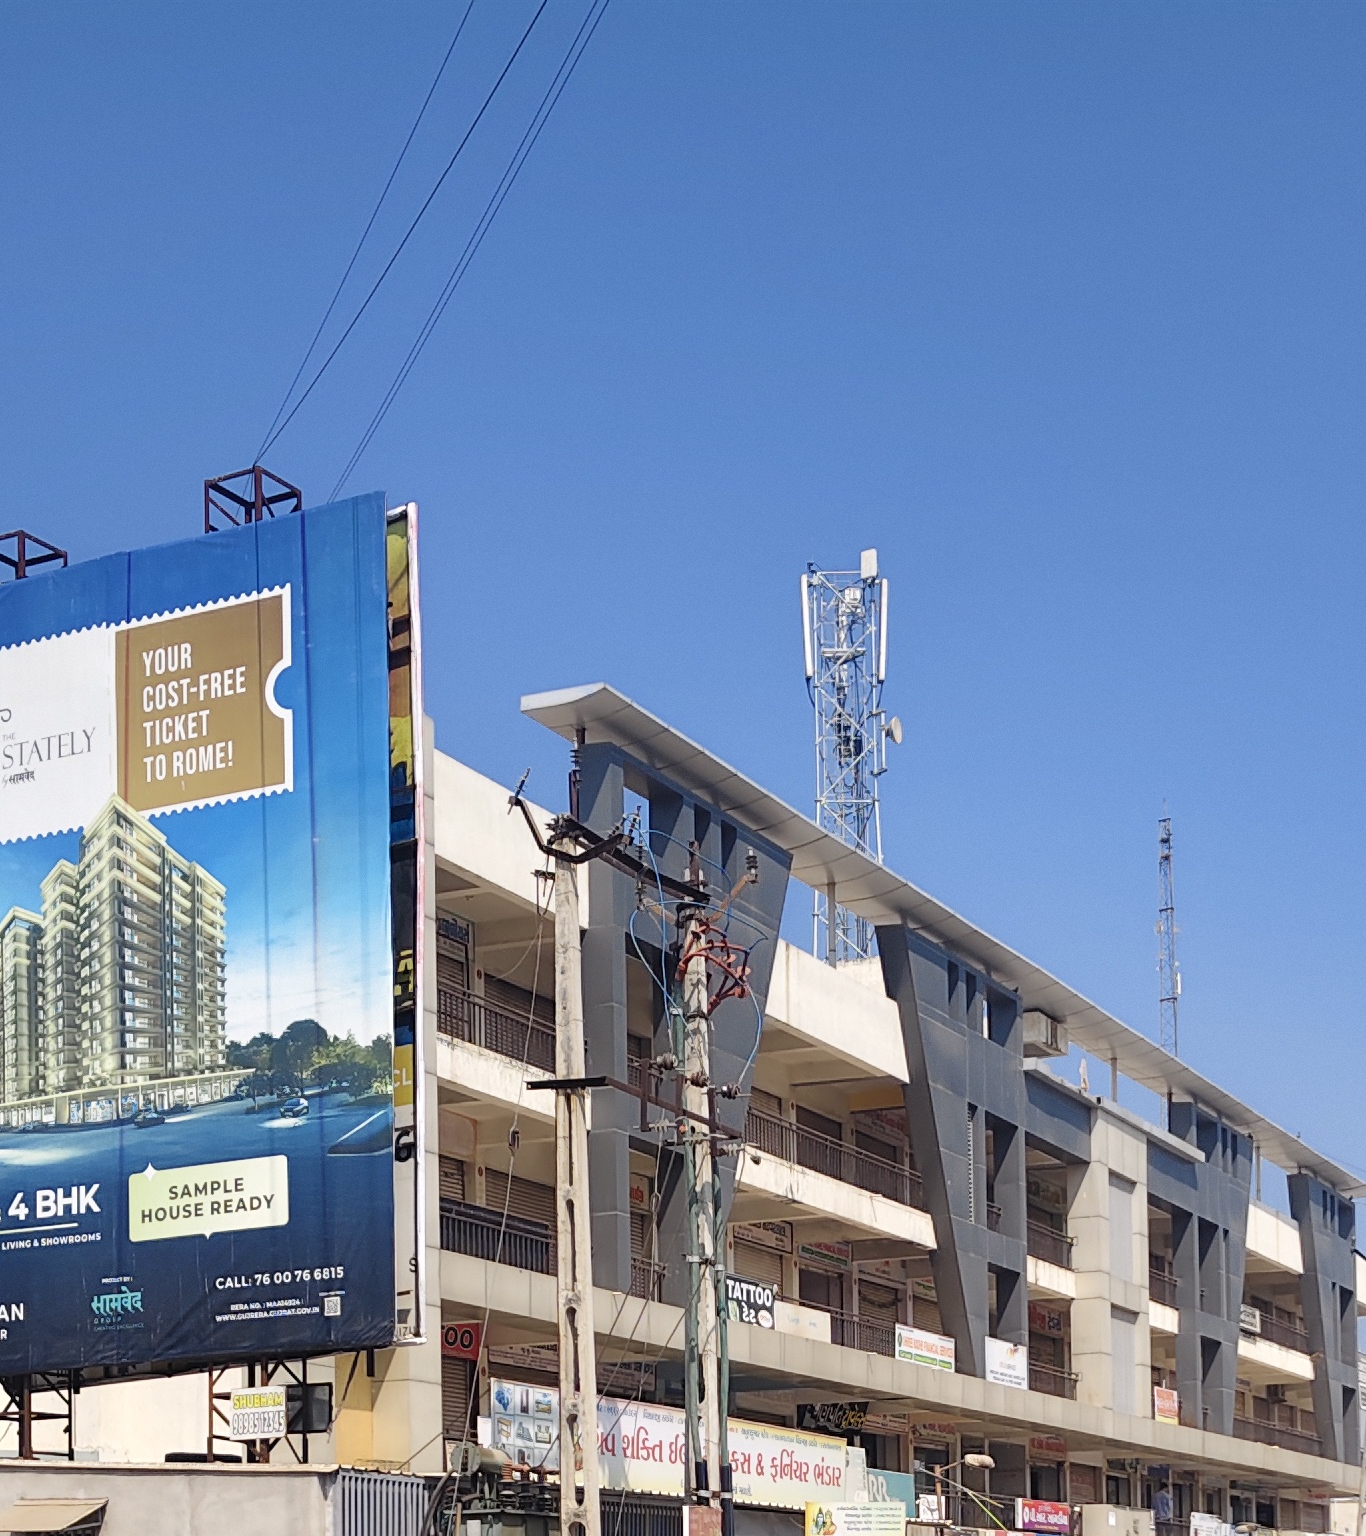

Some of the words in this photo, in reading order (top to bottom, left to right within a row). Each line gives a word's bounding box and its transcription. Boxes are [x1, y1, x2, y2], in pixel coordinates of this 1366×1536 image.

[142, 643, 192, 677] YOUR
[142, 666, 246, 712] COST-FREE
[2, 732, 16, 742] THE
[142, 709, 210, 748] TICKET
[2, 727, 96, 770] STATELY
[143, 753, 167, 783] TO
[172, 741, 234, 779] ROME!
[8, 1192, 29, 1220] 4
[36, 1183, 101, 1219] BHK
[168, 1177, 245, 1201] SAMPLE
[140, 1202, 205, 1225] HOUSE
[210, 1193, 276, 1217] READY
[2, 1239, 31, 1251] LIVING
[33, 1239, 39, 1247] &
[41, 1232, 101, 1247] SHOWROOMS
[254, 1273, 271, 1286] 76
[274, 1271, 291, 1284] 00
[294, 1269, 311, 1283] 76
[314, 1266, 344, 1281] 6815
[90, 1286, 144, 1316] सामवेद
[726, 1279, 772, 1307] TATTOO
[233, 1392, 284, 1410] SHUBHAM
[755, 1453, 764, 1476] &
[813, 1456, 842, 1487] ભંડાર
